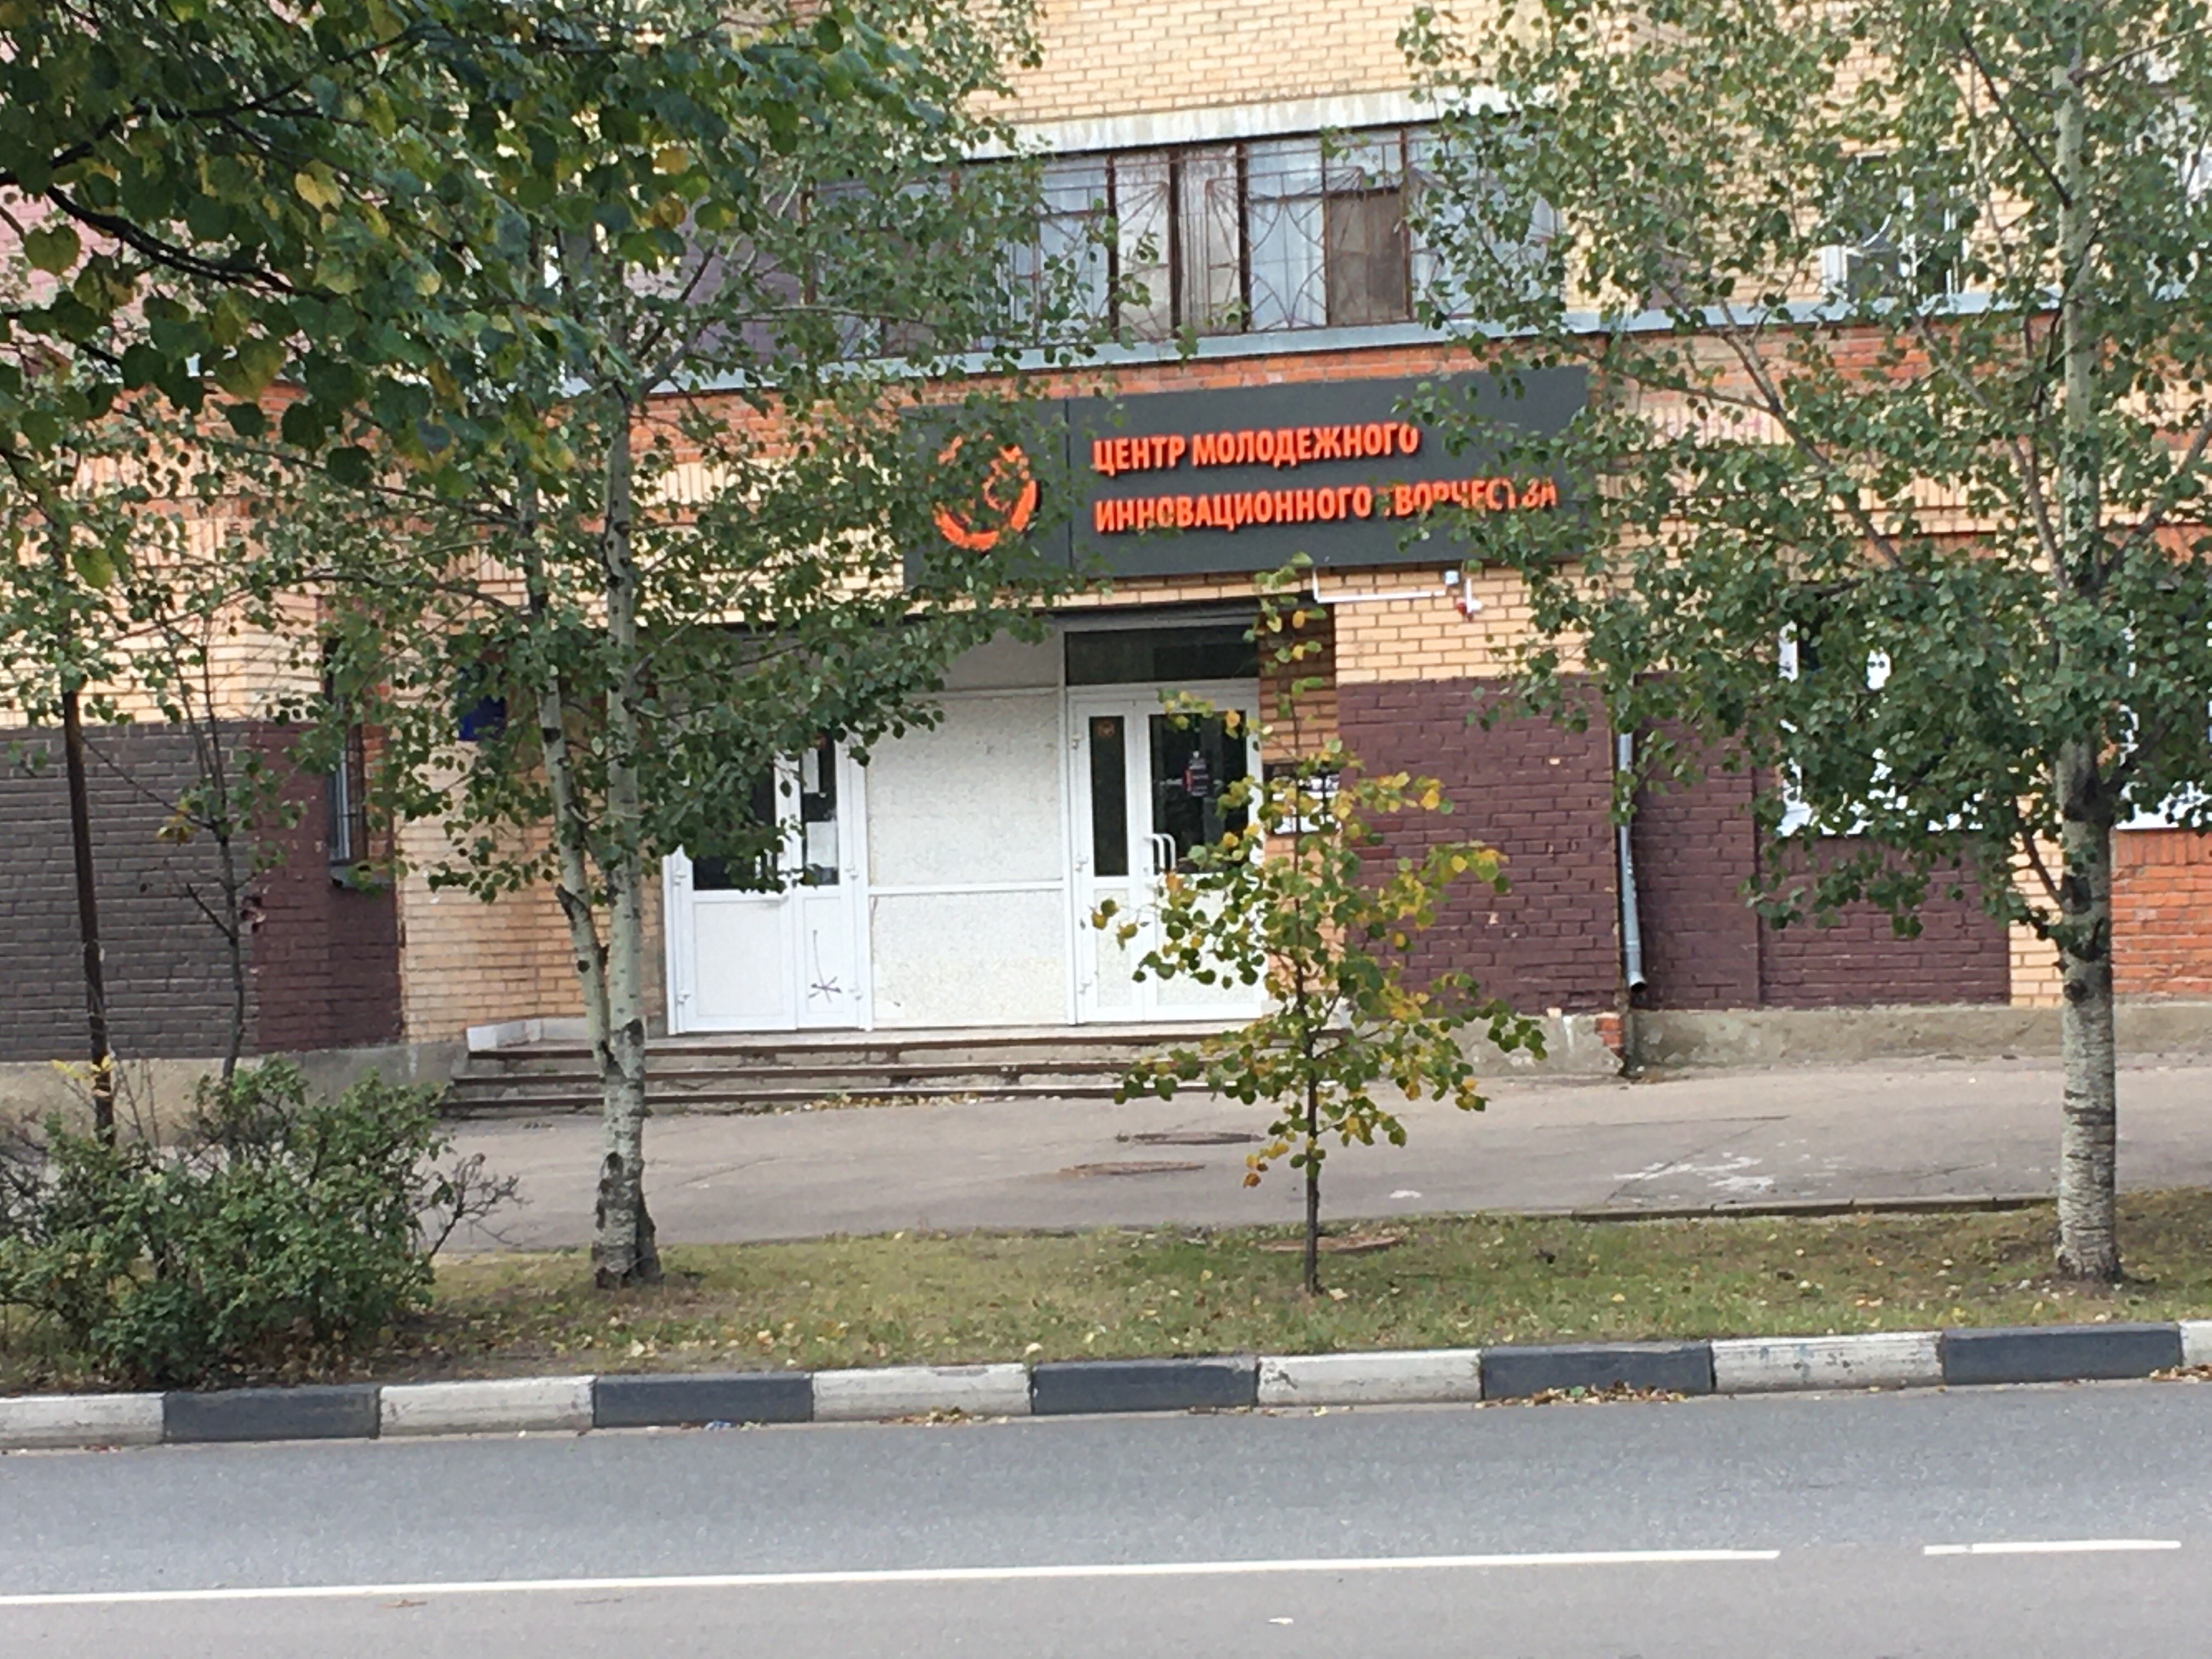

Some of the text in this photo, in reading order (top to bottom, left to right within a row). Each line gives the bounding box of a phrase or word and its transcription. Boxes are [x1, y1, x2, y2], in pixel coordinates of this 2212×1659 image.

[1094, 421, 1420, 477] ЦЕНТР МОЛОДЕЖНОГО
[1095, 486, 1372, 532] ИННОВАЦИОННОГО
